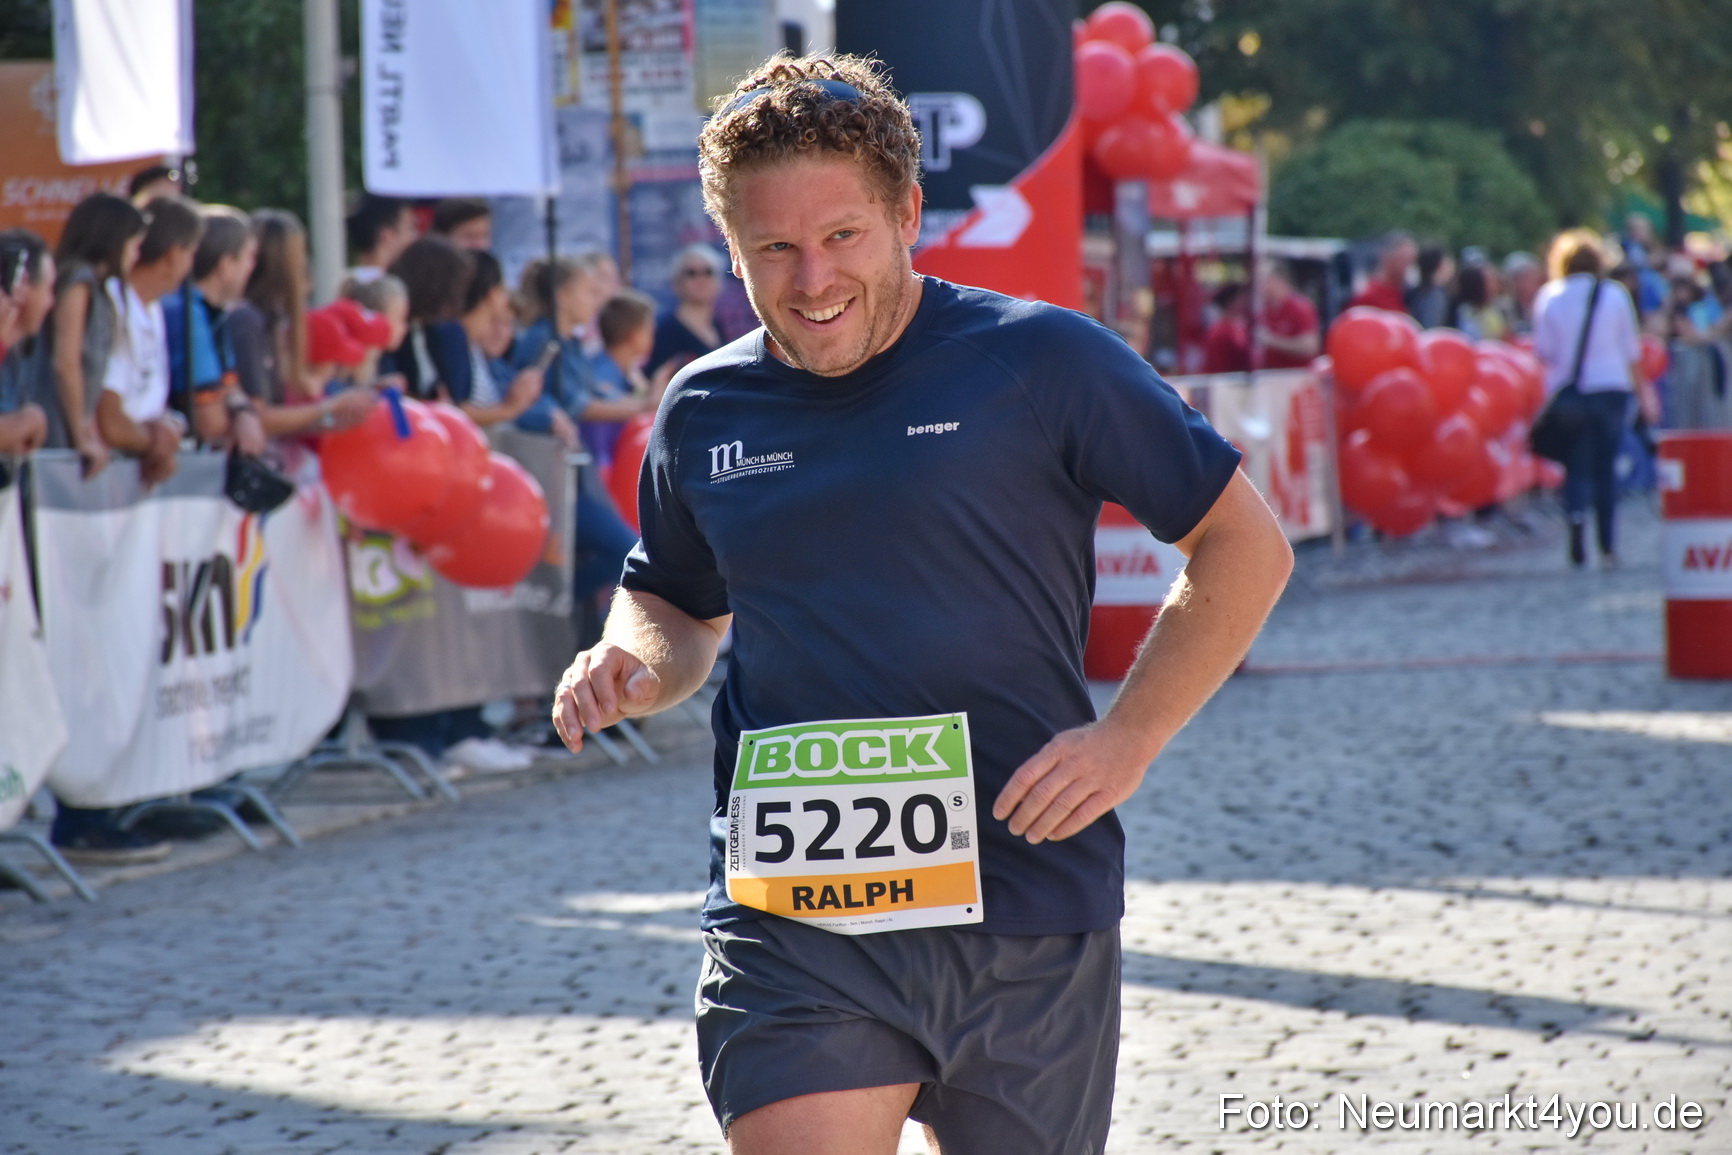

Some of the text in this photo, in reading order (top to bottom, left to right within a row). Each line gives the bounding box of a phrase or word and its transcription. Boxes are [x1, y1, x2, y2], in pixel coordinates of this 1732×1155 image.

[907, 421, 960, 436] benger
[736, 452, 793, 467] MÜNCH & MÜNCH
[749, 727, 946, 781] BOCK
[953, 795, 963, 807] S
[755, 794, 948, 863] 5220
[791, 878, 914, 911] RALPH
